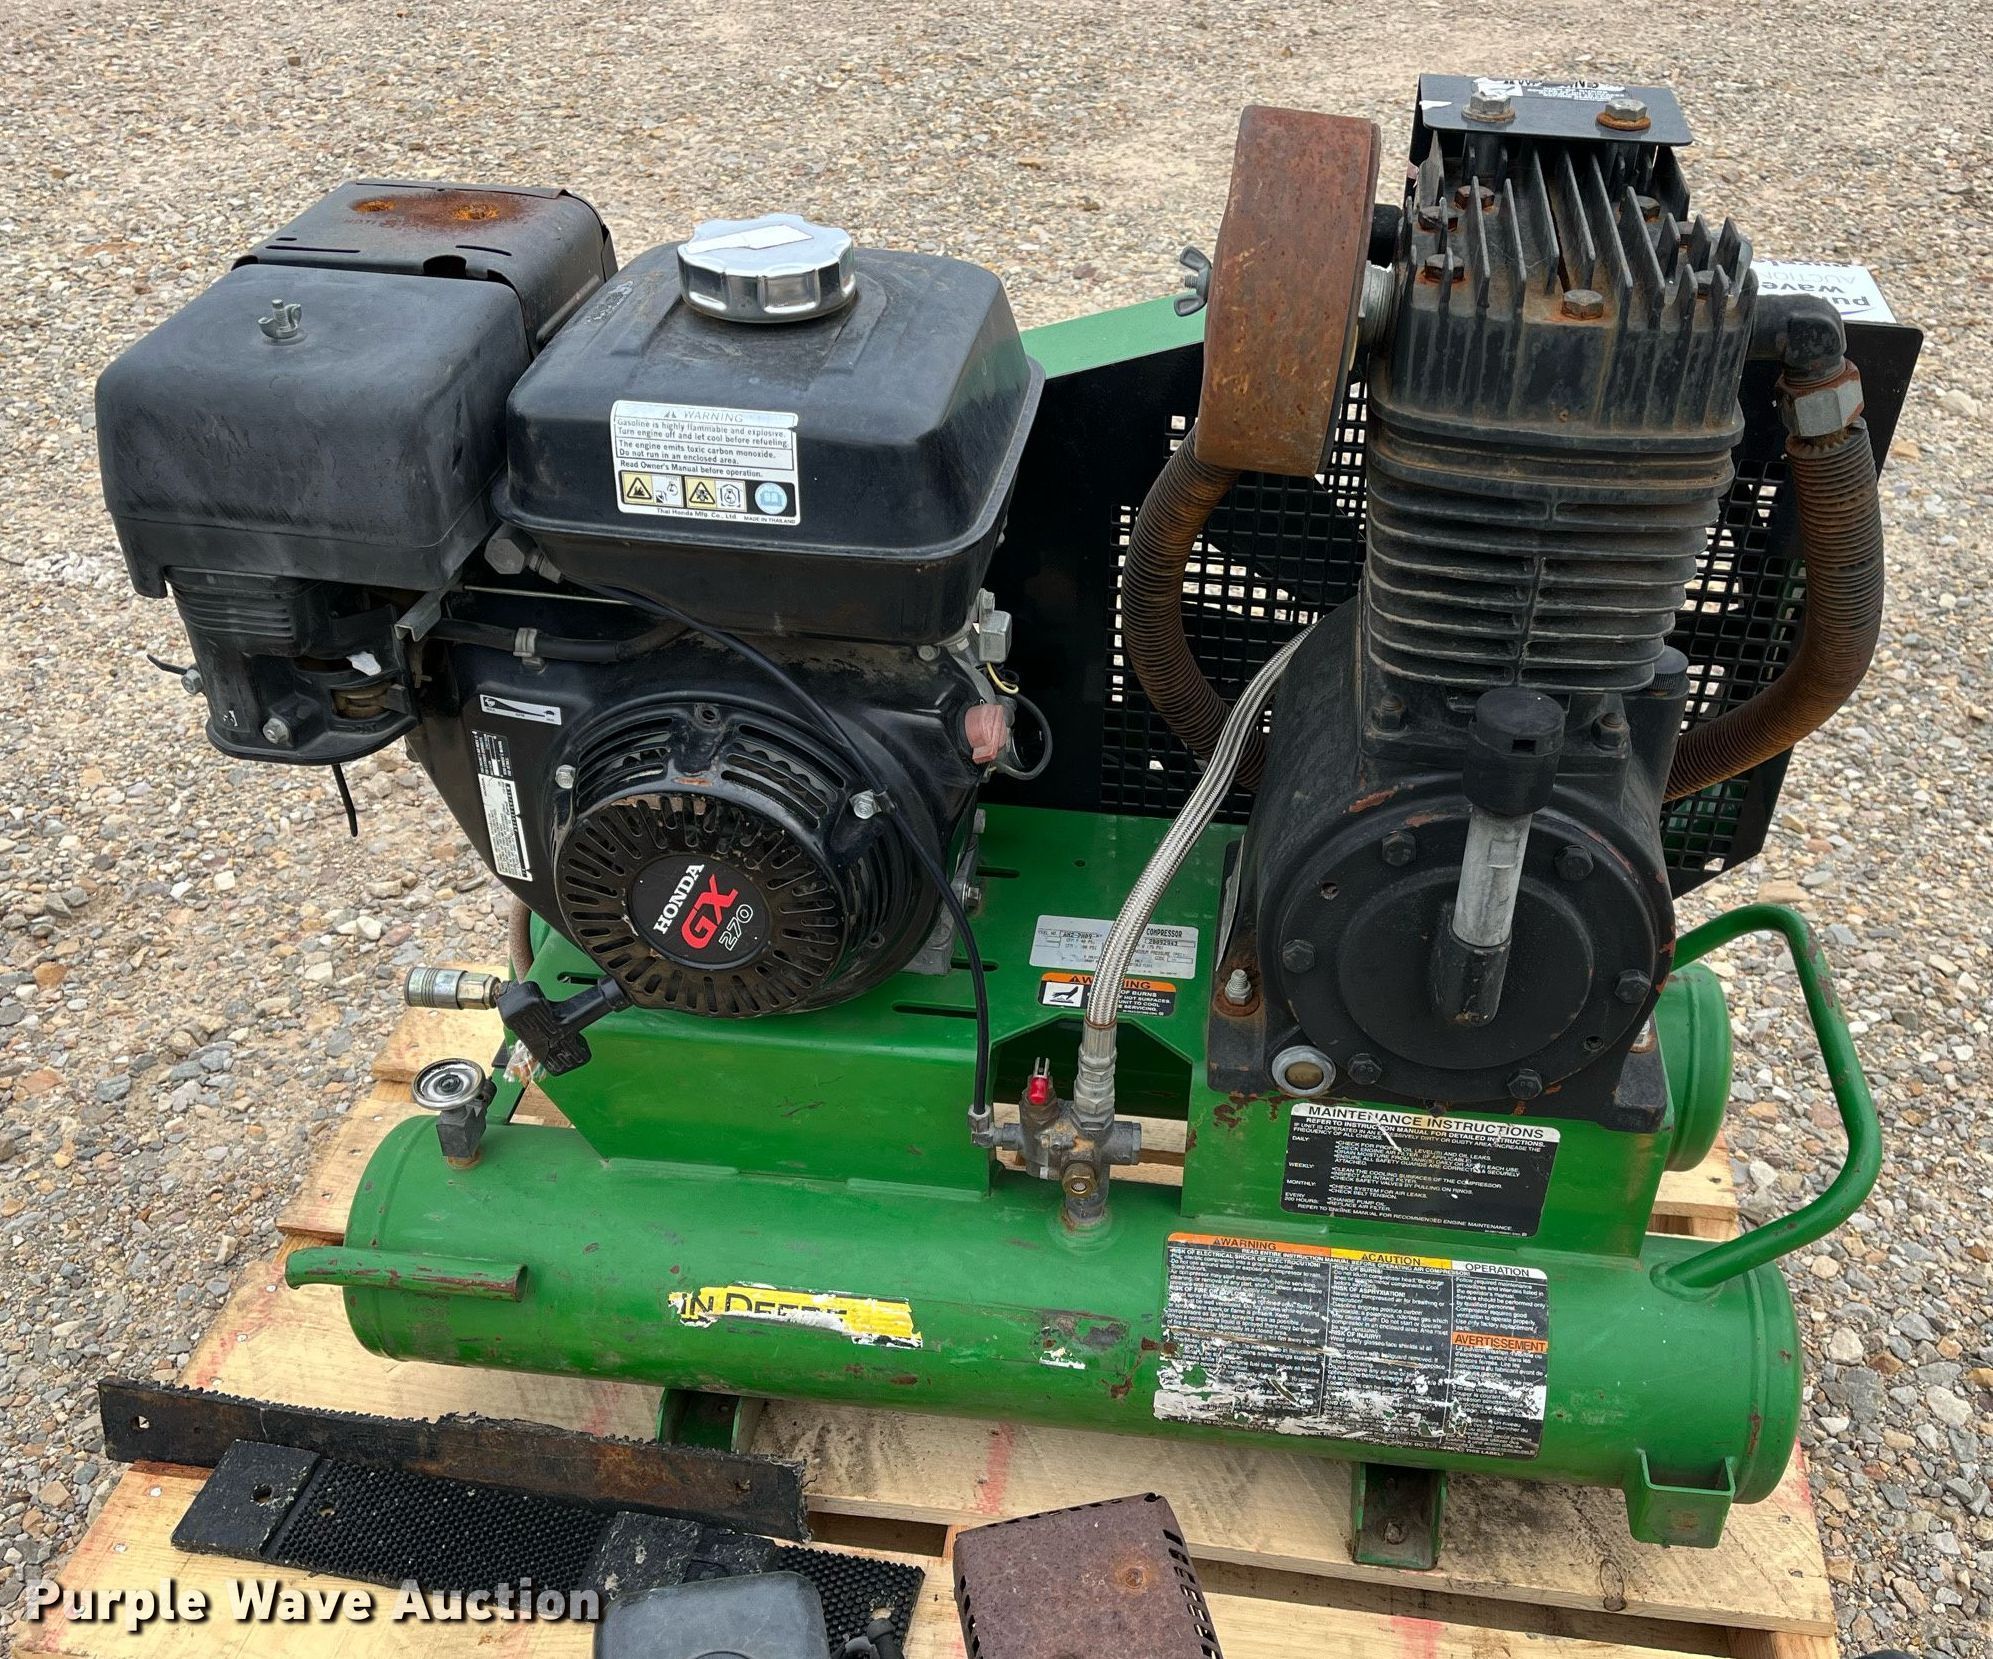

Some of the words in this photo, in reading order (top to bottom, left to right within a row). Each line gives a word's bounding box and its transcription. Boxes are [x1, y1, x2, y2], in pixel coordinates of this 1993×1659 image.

[1761, 282, 1846, 294] wave
[684, 410, 743, 422] WARNING
[617, 419, 649, 427] Gasoline
[661, 422, 684, 431] highly
[618, 427, 634, 435] Turn
[637, 429, 662, 438] engine
[725, 435, 749, 443] before
[635, 441, 660, 451] engine
[663, 443, 684, 451] emits
[707, 446, 733, 454] carbon
[736, 448, 775, 457] monoxide.
[683, 453, 716, 462] enclosed
[620, 459, 638, 467] Read
[640, 461, 669, 470] Owner's
[671, 463, 697, 472] Manual
[700, 465, 723, 473] before
[726, 467, 762, 478] operation.
[653, 864, 705, 934] HONDA
[681, 874, 739, 949] GX
[719, 904, 754, 951] 270
[1146, 928, 1182, 937] COMPRESSOR
[1306, 1117, 1331, 1125] REFER
[1344, 1121, 1394, 1131] INSTRUCION
[1396, 1126, 1429, 1134] MANUAL
[1448, 1132, 1485, 1140] DETAILED
[1309, 1106, 1422, 1126] MAINTENANCE
[1426, 1118, 1544, 1138] INSTRUCTIONS
[1220, 1237, 1276, 1250] WARNING
[1368, 1253, 1420, 1265] CAUTION
[1465, 1263, 1529, 1276] OPERATION
[1454, 1333, 1545, 1352] AVERTISSEMENT
